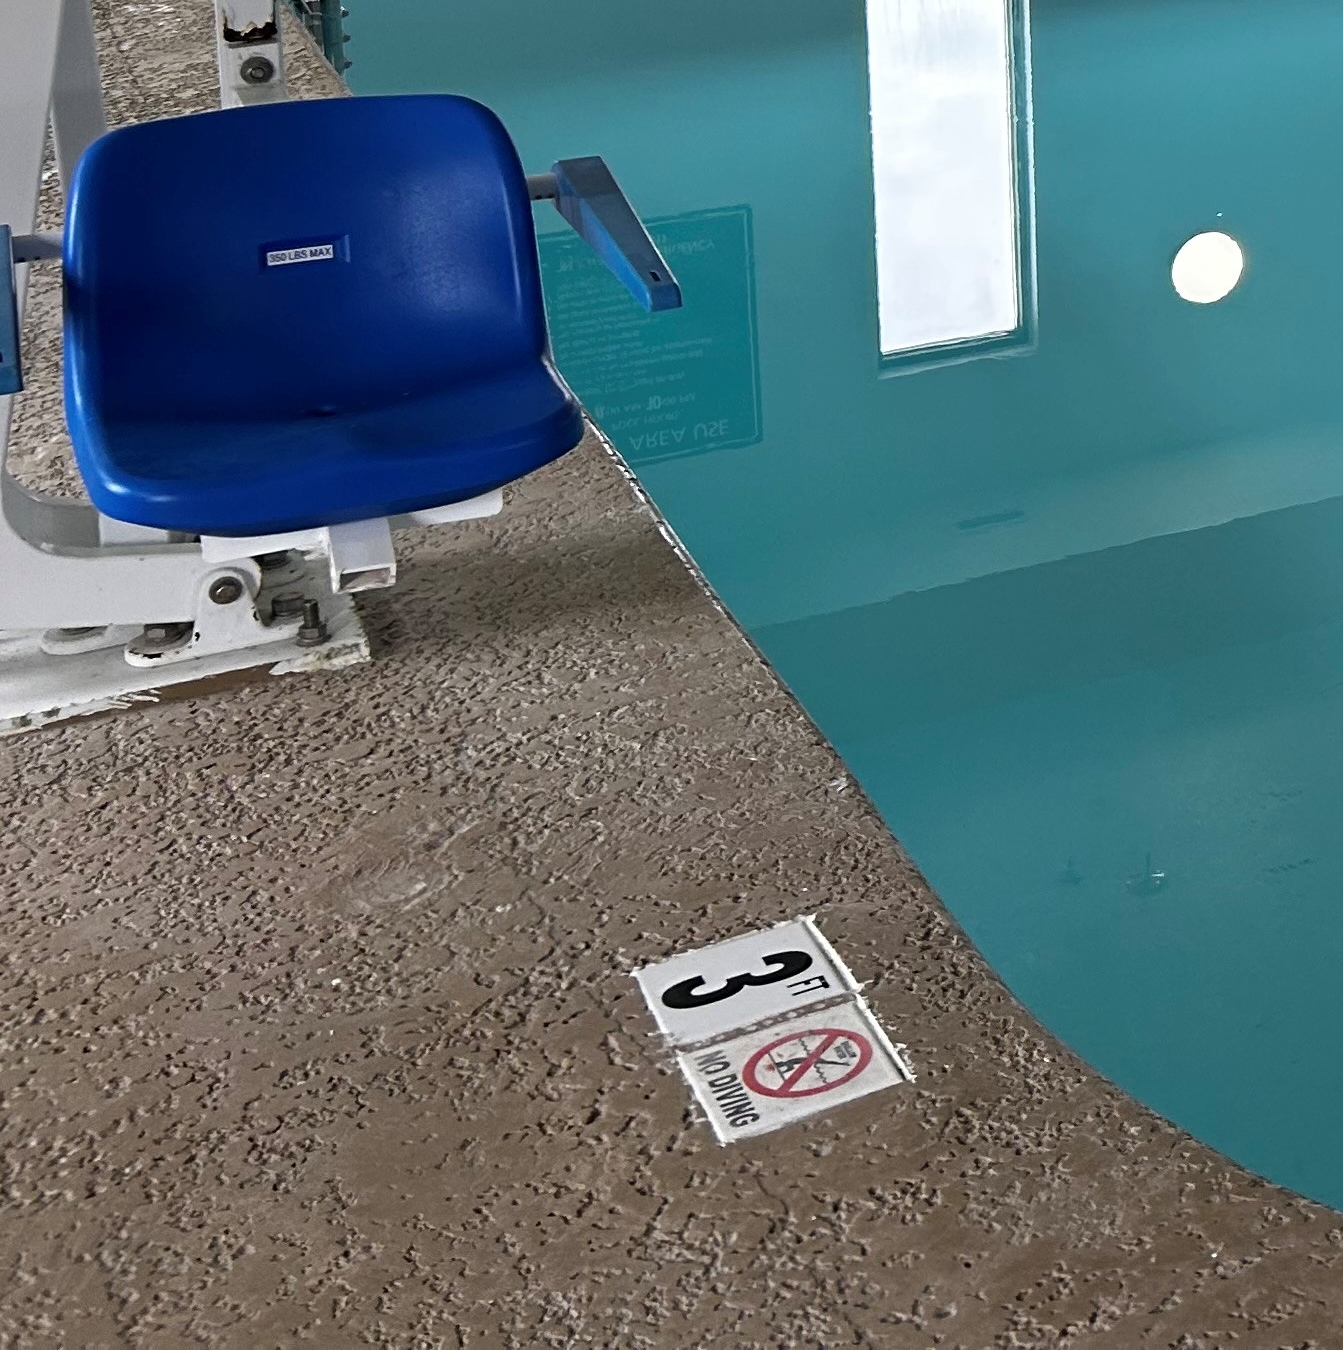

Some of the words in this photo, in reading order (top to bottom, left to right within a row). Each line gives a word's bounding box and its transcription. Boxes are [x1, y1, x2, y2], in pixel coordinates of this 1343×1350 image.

[288, 249, 307, 261] LBS
[309, 246, 332, 258] MAX
[661, 950, 813, 1009] 3
[786, 975, 831, 996] FT
[696, 1050, 730, 1075] NO
[708, 1072, 760, 1129] DIVING
